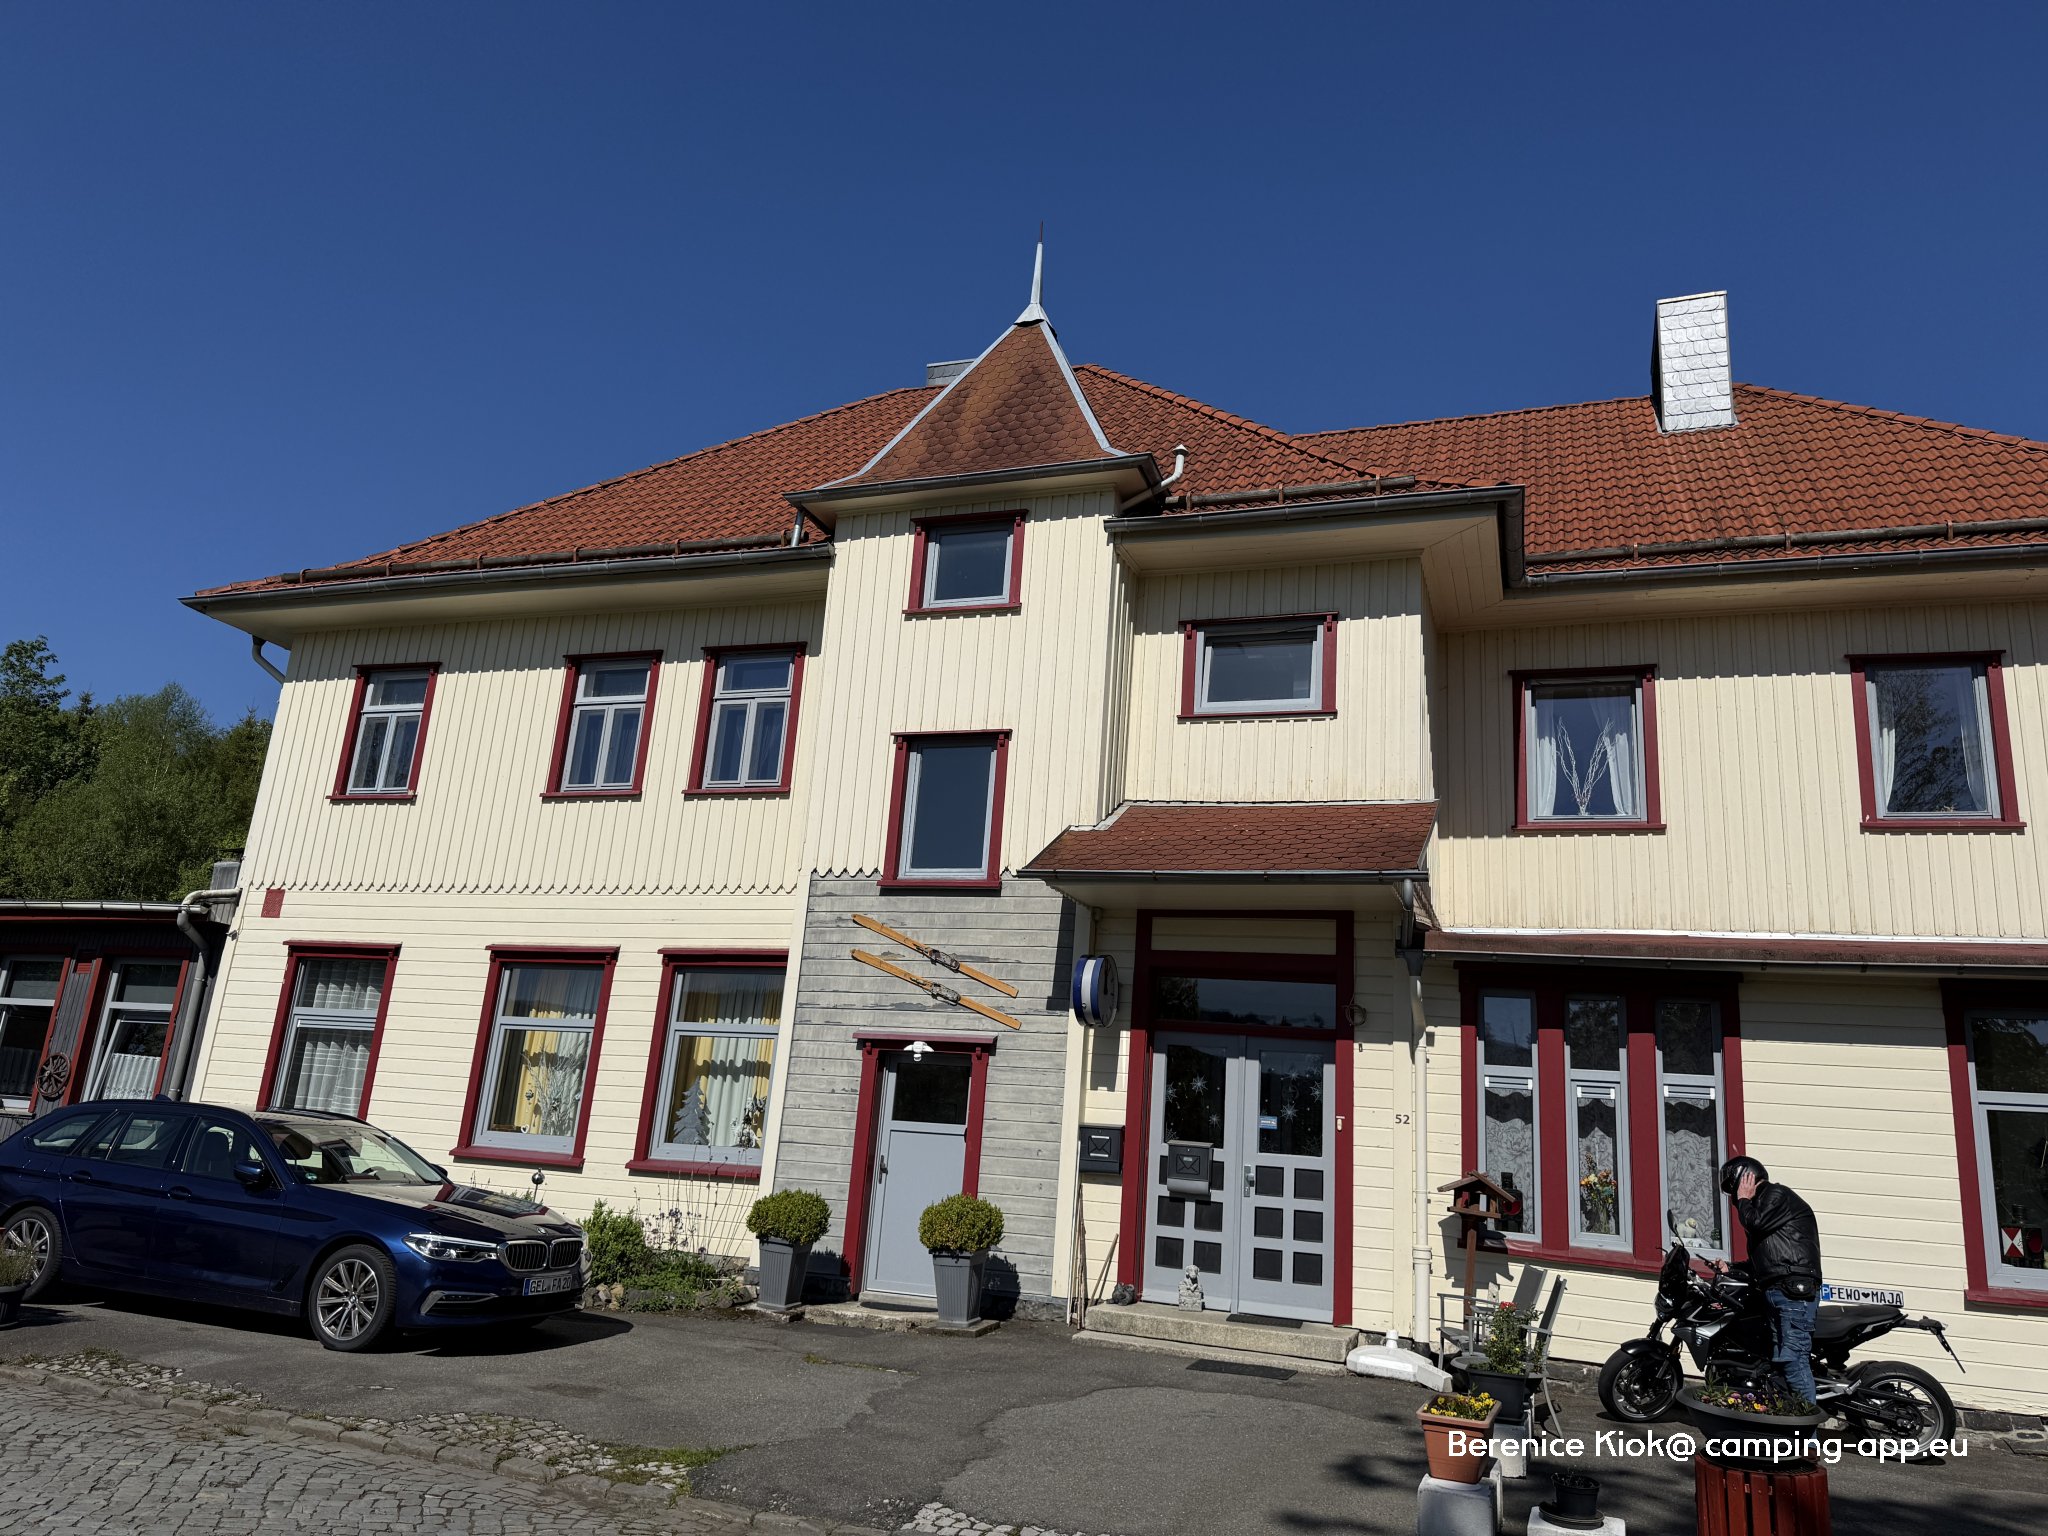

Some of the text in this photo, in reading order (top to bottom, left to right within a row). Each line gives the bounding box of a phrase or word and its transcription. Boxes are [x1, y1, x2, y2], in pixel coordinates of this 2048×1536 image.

[1395, 1114, 1410, 1125] 52
[530, 1279, 547, 1293] GEL
[1822, 1286, 1902, 1305] P FEWO MAJA
